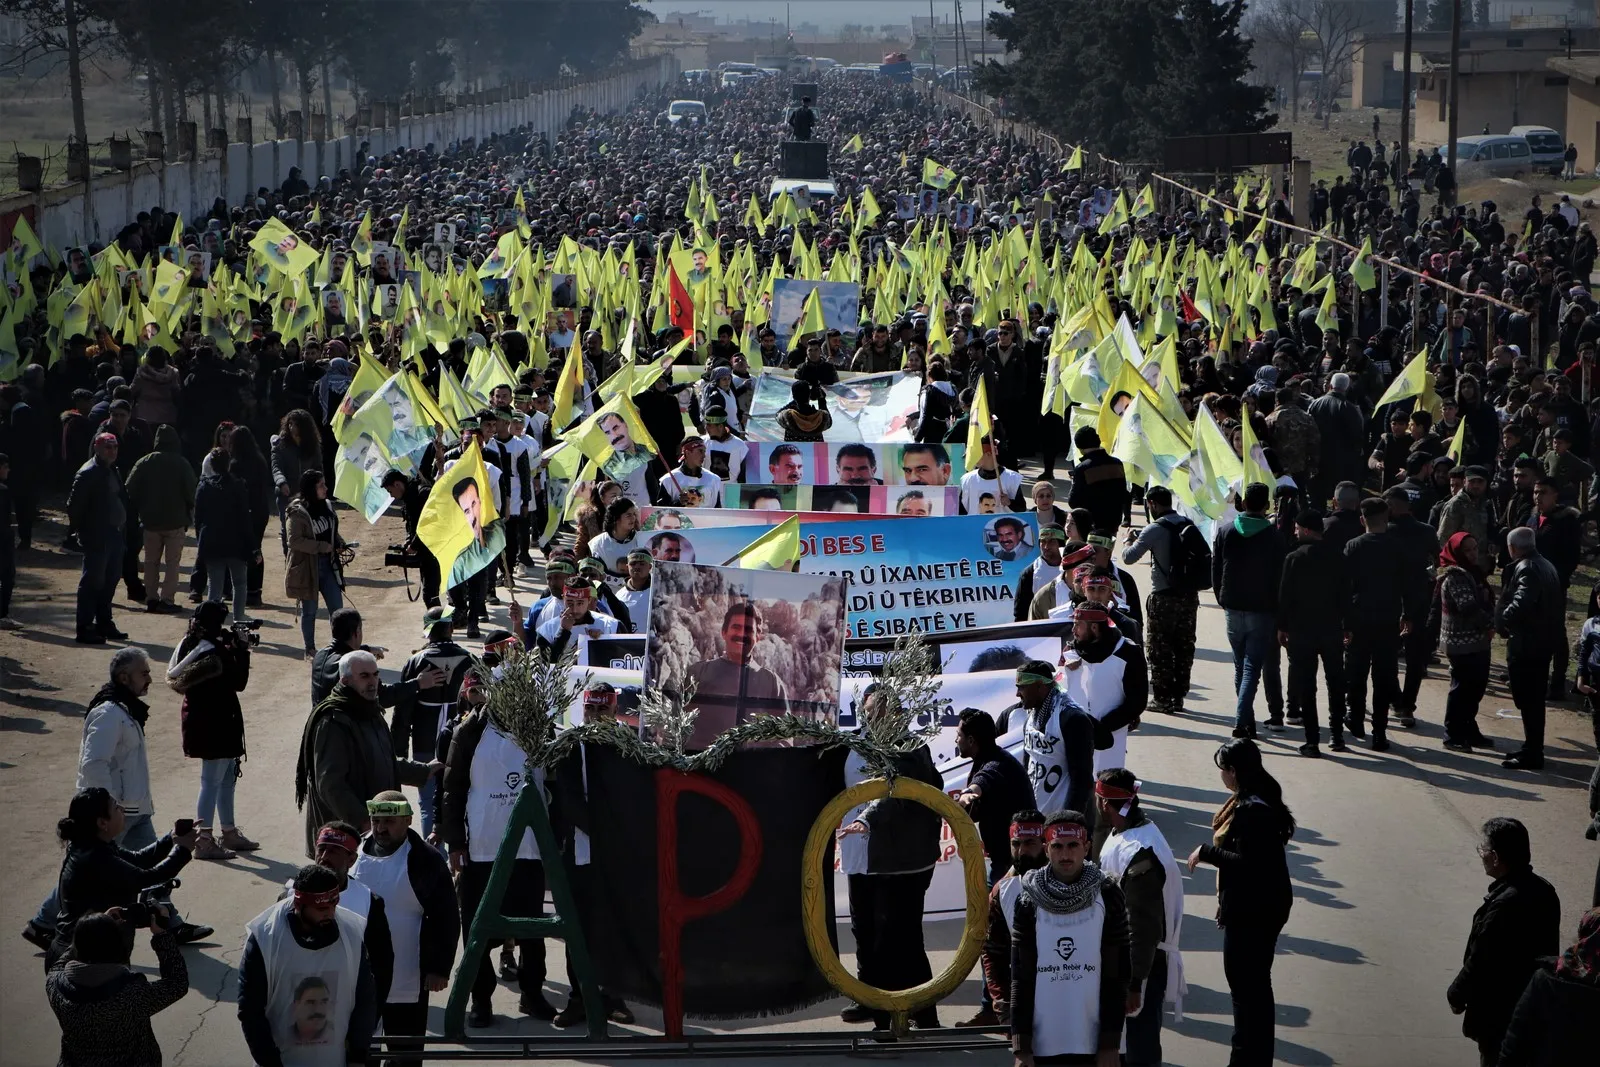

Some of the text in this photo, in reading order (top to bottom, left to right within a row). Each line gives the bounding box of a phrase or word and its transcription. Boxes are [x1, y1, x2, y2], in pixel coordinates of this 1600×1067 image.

[822, 535, 867, 556] BES
[871, 533, 886, 553] E
[860, 565, 876, 585] Û
[880, 557, 972, 584] ÎXANETÊ
[976, 559, 1003, 577] RE
[847, 584, 1014, 612] DÎ Û TÊKBIRINA
[857, 618, 869, 638] Ê
[949, 612, 976, 629] YE
